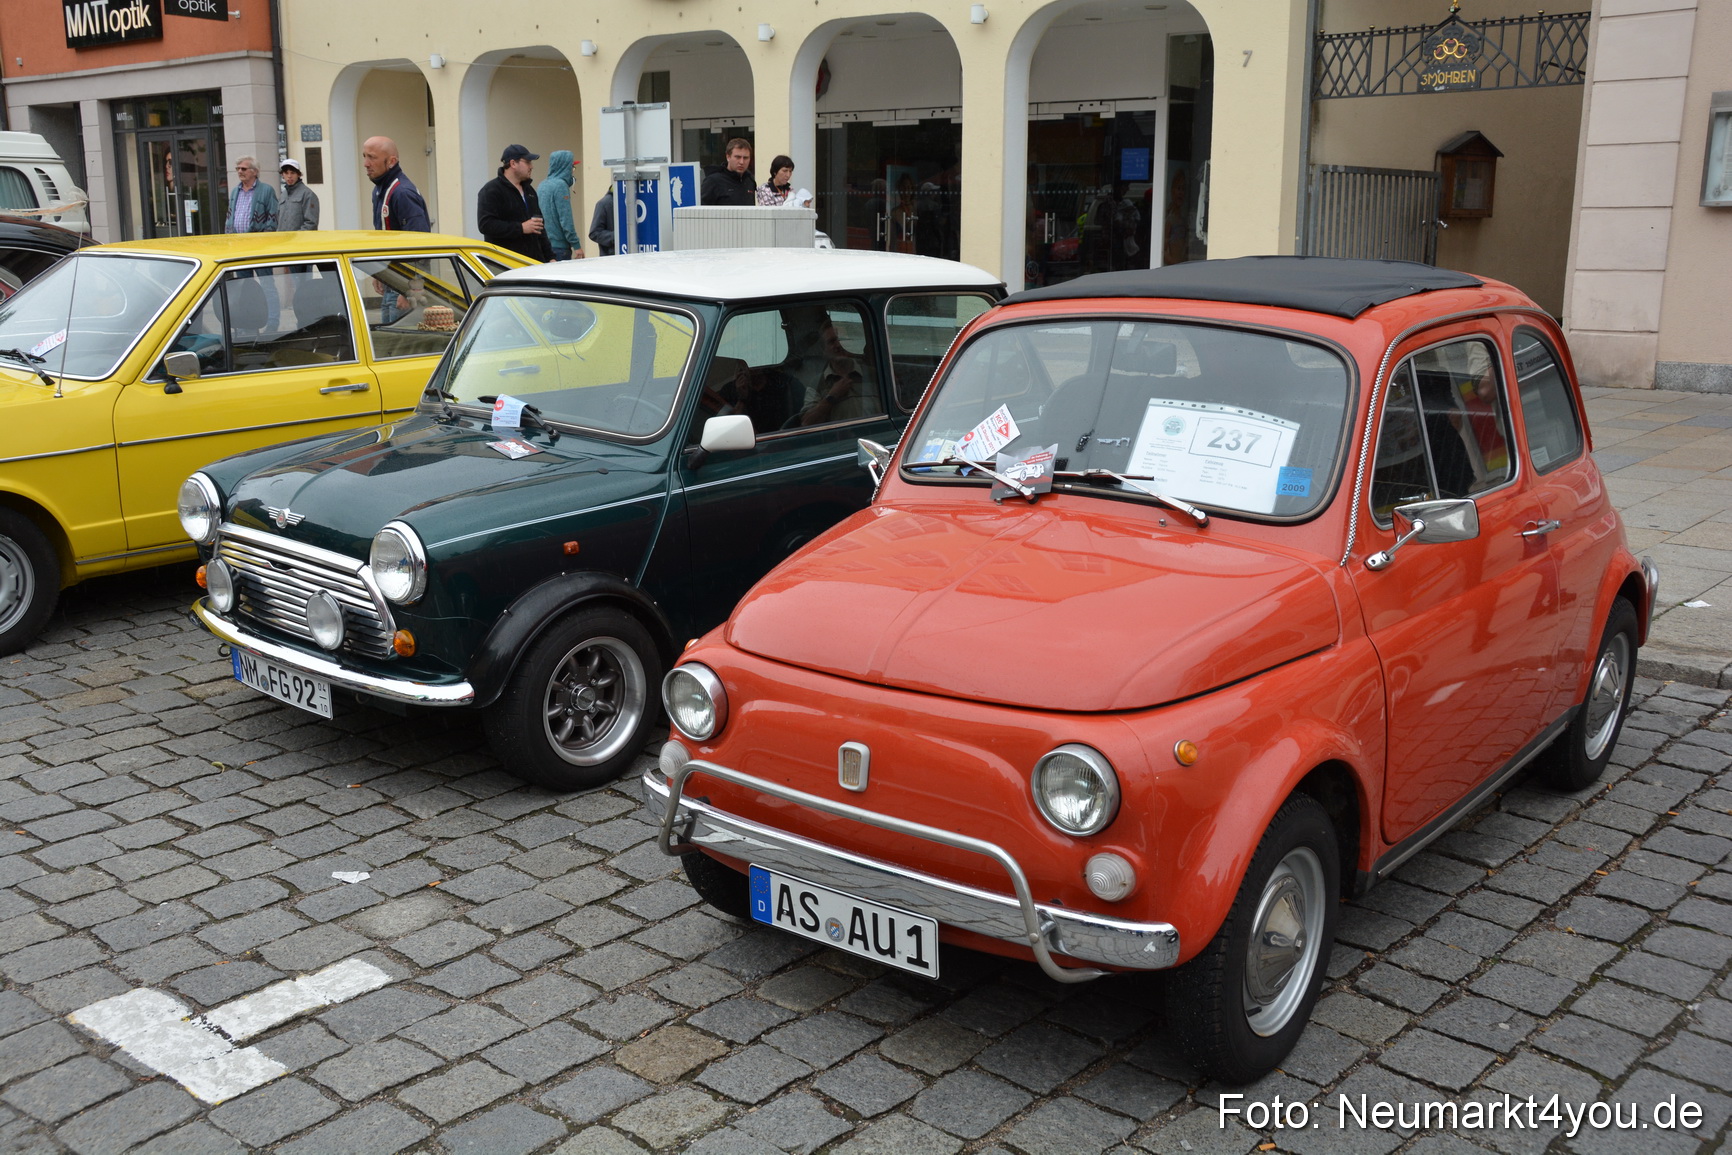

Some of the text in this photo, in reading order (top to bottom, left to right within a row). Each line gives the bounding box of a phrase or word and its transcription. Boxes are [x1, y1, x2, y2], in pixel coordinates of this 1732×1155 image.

[1242, 50, 1253, 68] 7
[1206, 426, 1262, 455] 237
[1281, 483, 1306, 493] 2009
[239, 652, 260, 687] NM
[757, 900, 766, 912] D
[776, 883, 820, 932] AS
